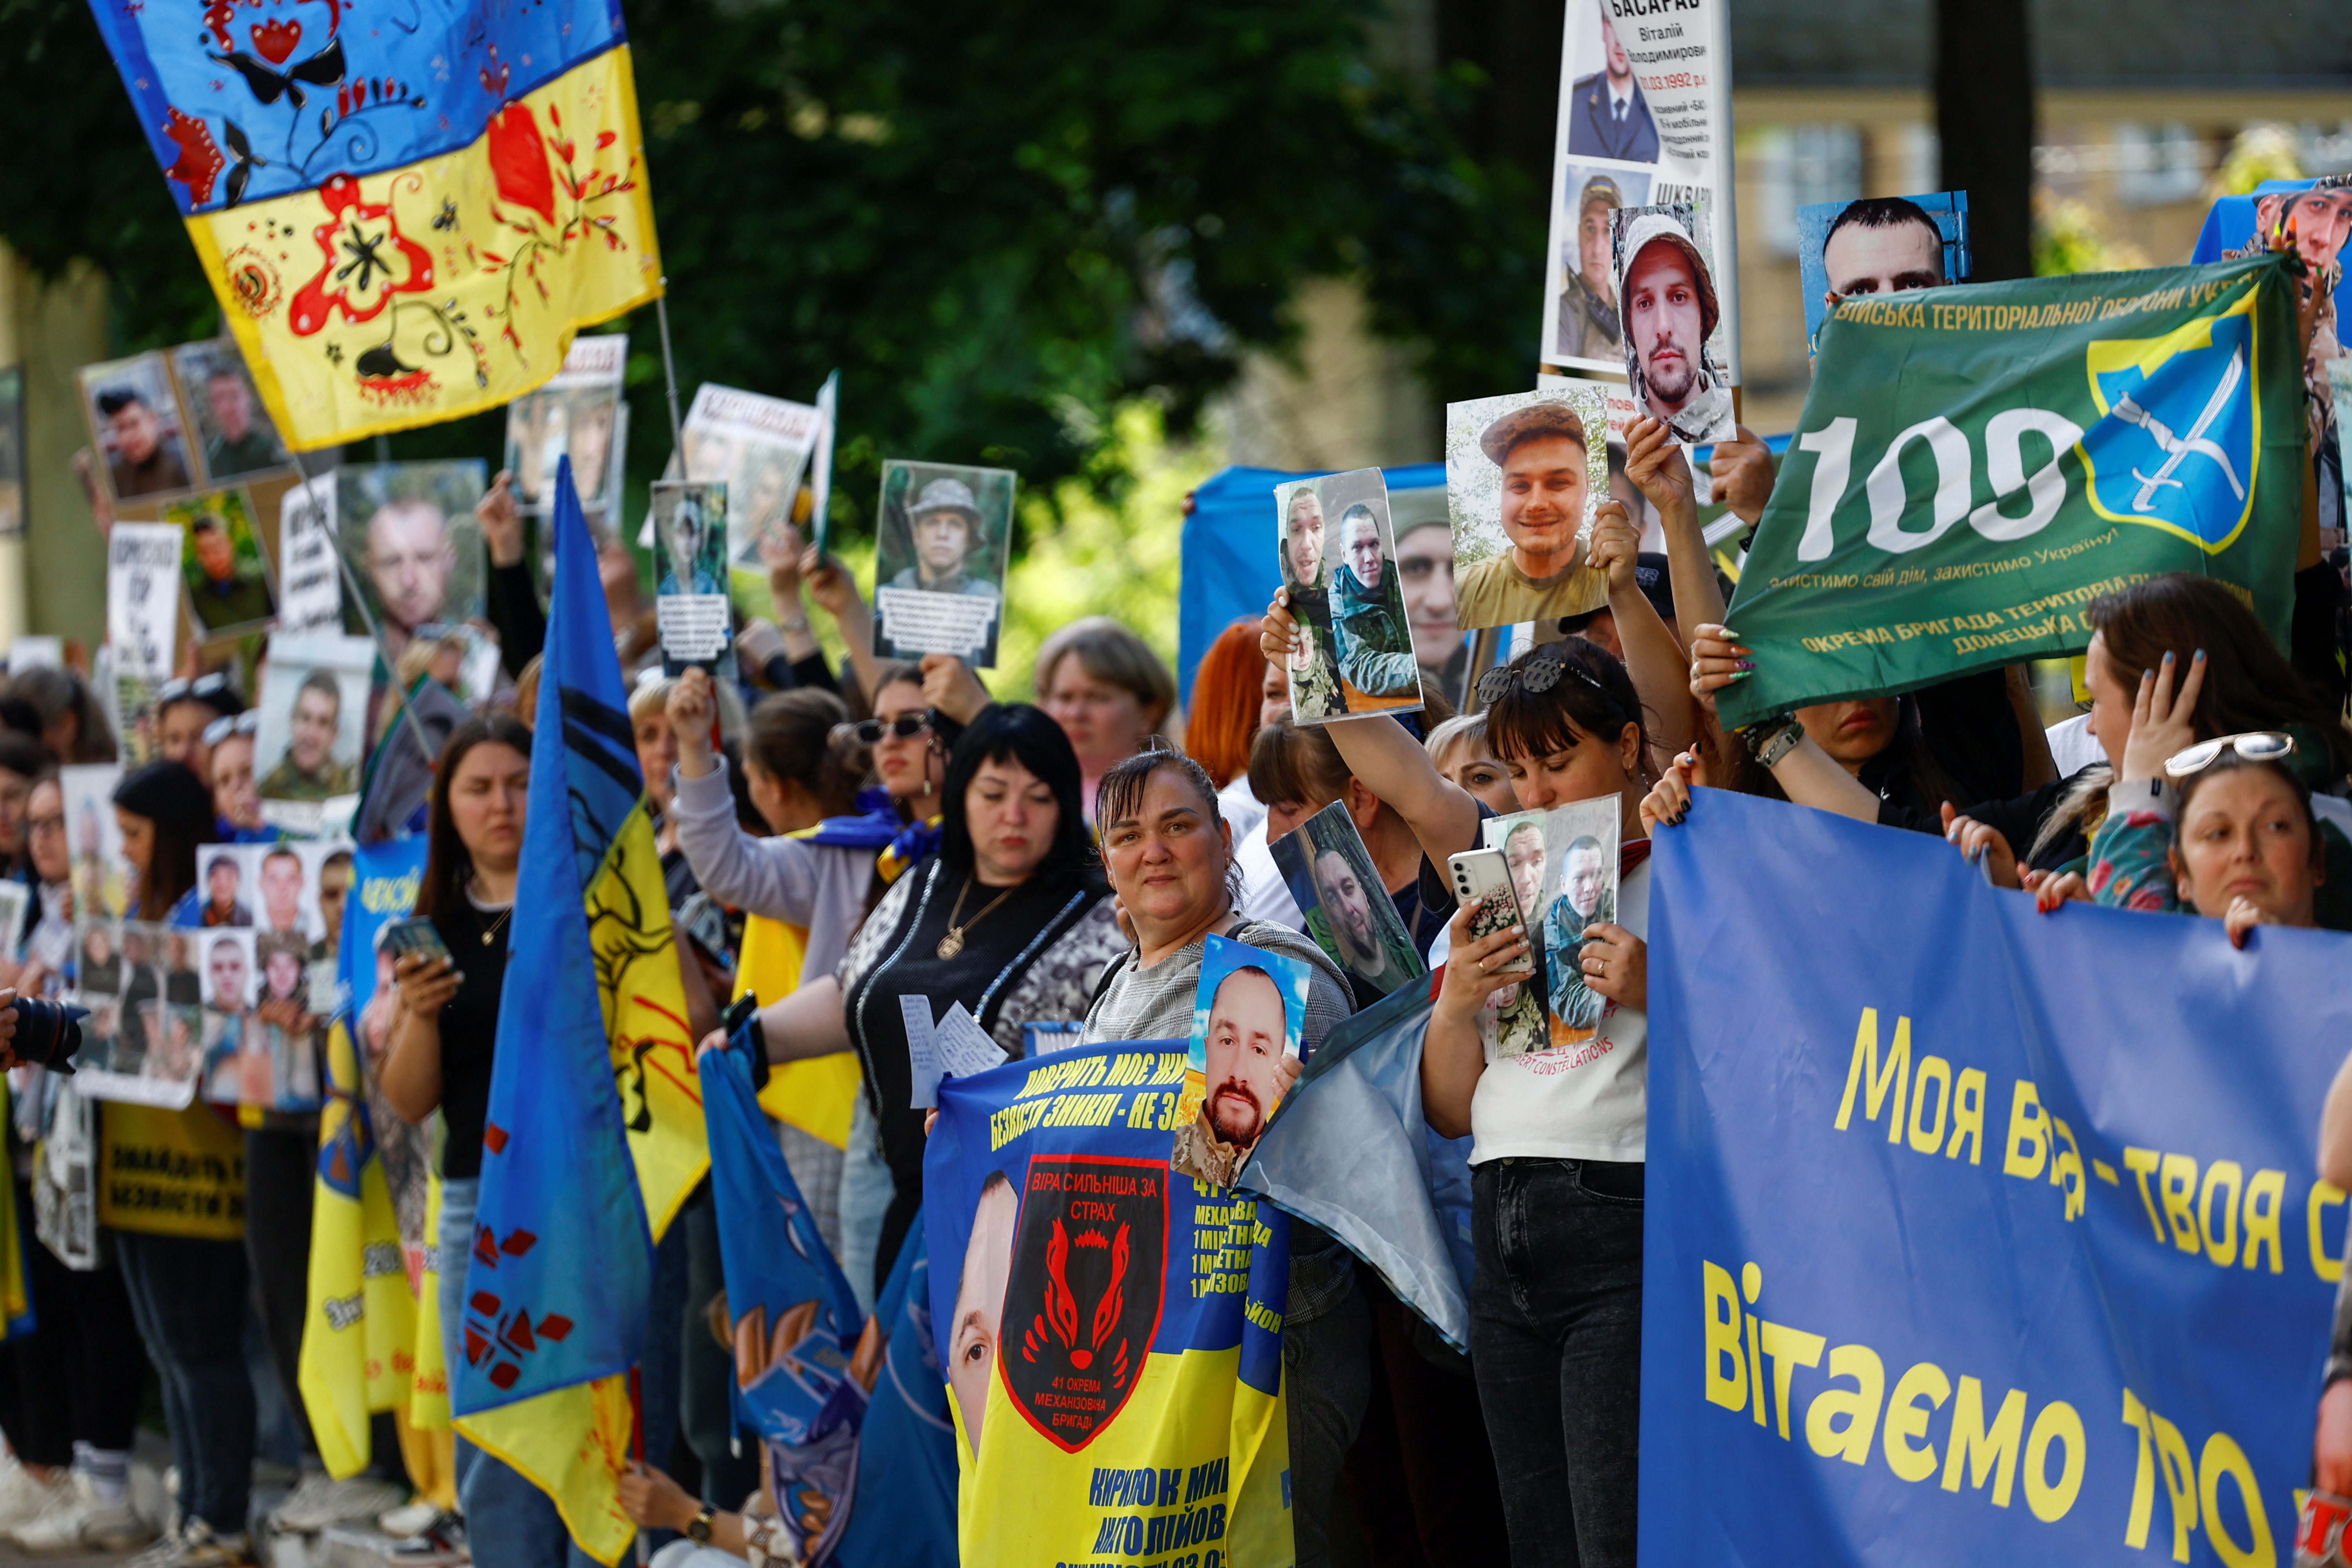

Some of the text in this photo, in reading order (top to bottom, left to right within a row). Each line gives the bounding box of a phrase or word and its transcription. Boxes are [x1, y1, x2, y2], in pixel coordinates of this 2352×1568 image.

[1639, 22, 1684, 42] Віталій
[1835, 299, 1925, 328] ВІЙСЬКА
[1931, 295, 2102, 330] ТЕРИТОРІАЛЬНОЇ
[1798, 408, 2084, 561] 109
[2033, 527, 2120, 564] Україну!
[1801, 626, 1894, 653] ОКРЕМА
[1894, 611, 2005, 640] БРИГАДА
[1952, 614, 2076, 656] ДОНЕЦЬКА
[1102, 1052, 1154, 1087] МОЄ
[1533, 1036, 1614, 1075] CONSTELLATIONS
[990, 1097, 1054, 1152] БЕЗВІСТИ
[1042, 1093, 1118, 1128] ЗНИКЛІ
[1127, 1092, 1159, 1129] НЕ
[1031, 1172, 1157, 1197] ВІРА СИЛЬНІША ЗА
[1070, 1200, 1116, 1221] СТРАХ
[1052, 1376, 1101, 1392] 41 ОКРЕМА
[1034, 1392, 1106, 1412] МЕХАНІЗОВАНА
[1703, 1259, 2278, 1568] Вітаємо ТРО
[1052, 1413, 1093, 1431] БРИГАДА
